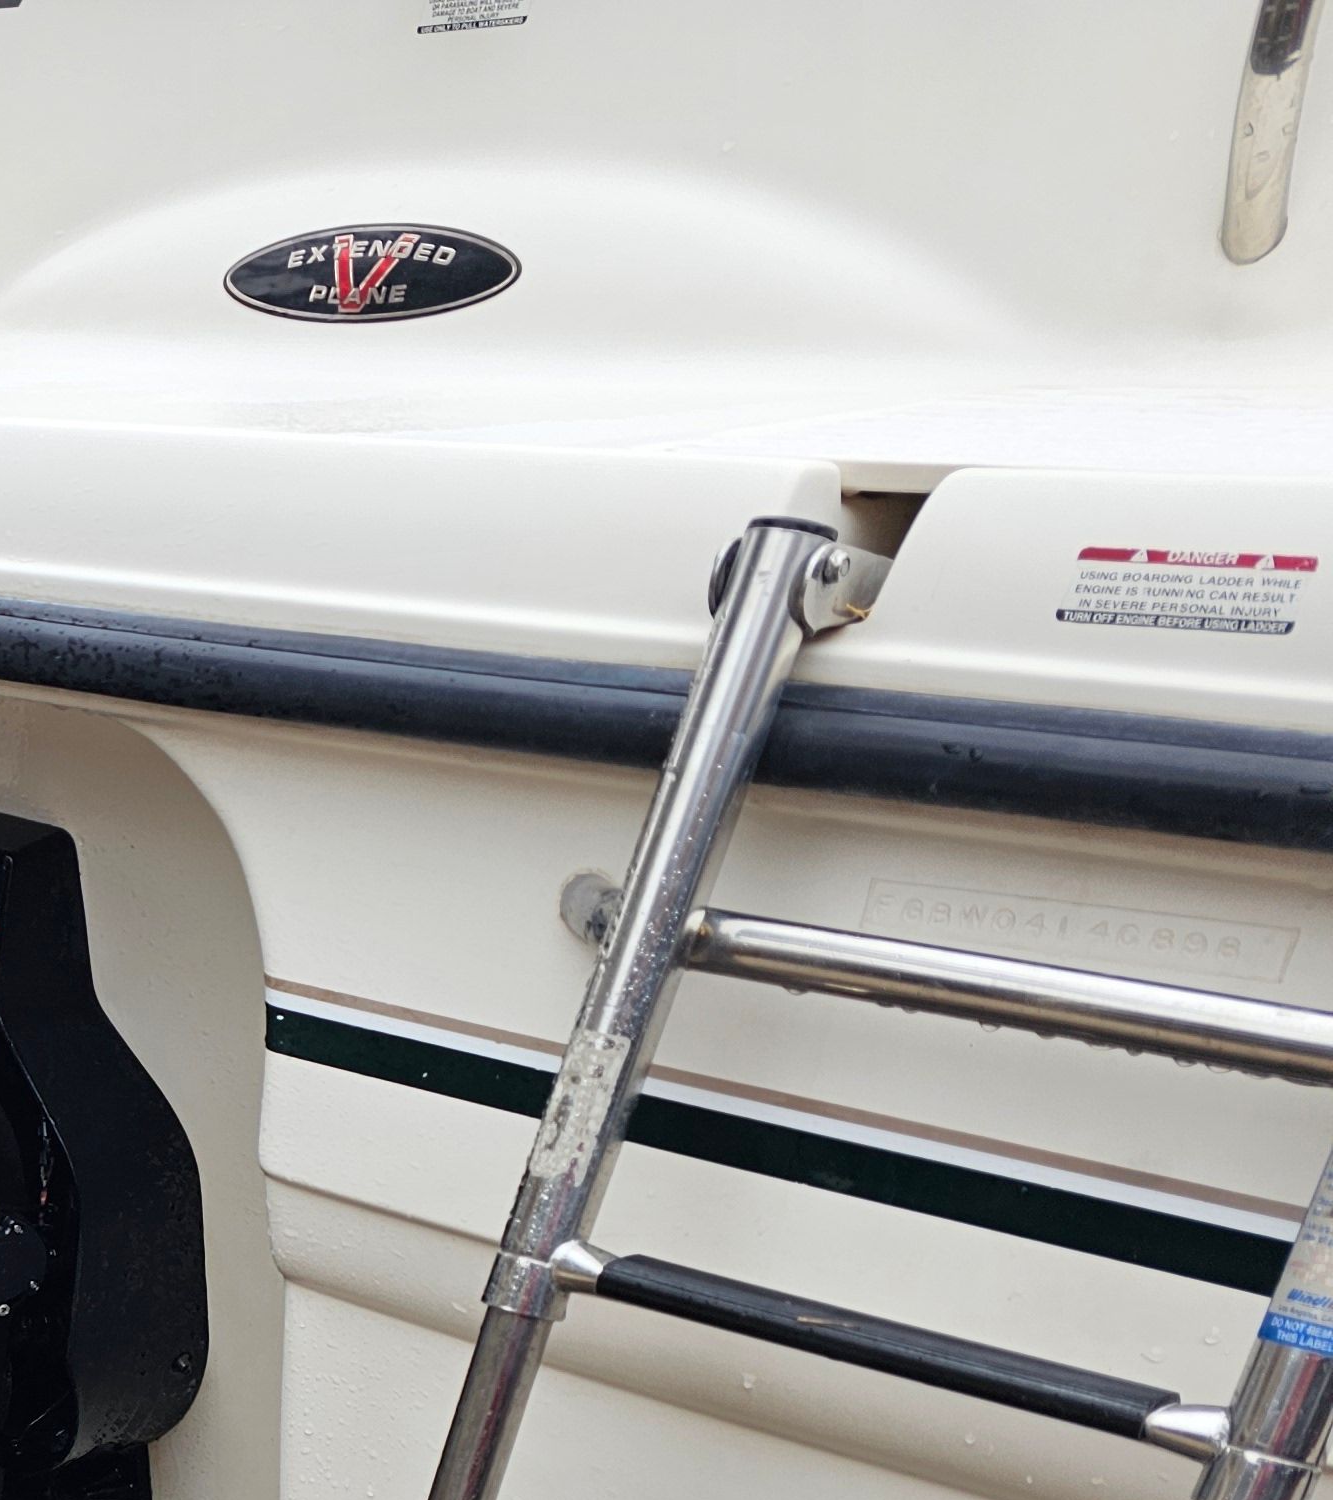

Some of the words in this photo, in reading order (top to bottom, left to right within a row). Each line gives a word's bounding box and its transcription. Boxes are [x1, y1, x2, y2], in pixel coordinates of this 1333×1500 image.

[287, 239, 456, 268] EXTENDED
[309, 284, 407, 304] PLANE
[1166, 551, 1240, 565] DANGER
[1080, 570, 1118, 581] USING
[1122, 571, 1193, 584] BOARDING
[1199, 575, 1254, 587] LADDER
[1262, 577, 1301, 590] WHILE
[1075, 584, 1122, 594] ENGINE
[1125, 586, 1138, 596] IS
[1143, 587, 1205, 600] RUNNING
[1209, 590, 1238, 601] CAN
[1242, 591, 1297, 603] RESULT
[1078, 598, 1092, 608] IN
[1095, 599, 1147, 610] SEVERE
[1152, 601, 1226, 616] PERSONAL
[1231, 605, 1282, 617] INJURY
[1064, 610, 1093, 622] TURN
[1093, 612, 1115, 623] OFF
[1116, 613, 1157, 626] ENGINE
[1157, 615, 1202, 629] BEFORE
[1204, 618, 1239, 630] USING
[1240, 619, 1287, 633] LADDER
[1271, 1315, 1284, 1328] DO
[1285, 1319, 1307, 1332] NOT
[1307, 1325, 1333, 1340] REM
[1277, 1329, 1298, 1344] THIS
